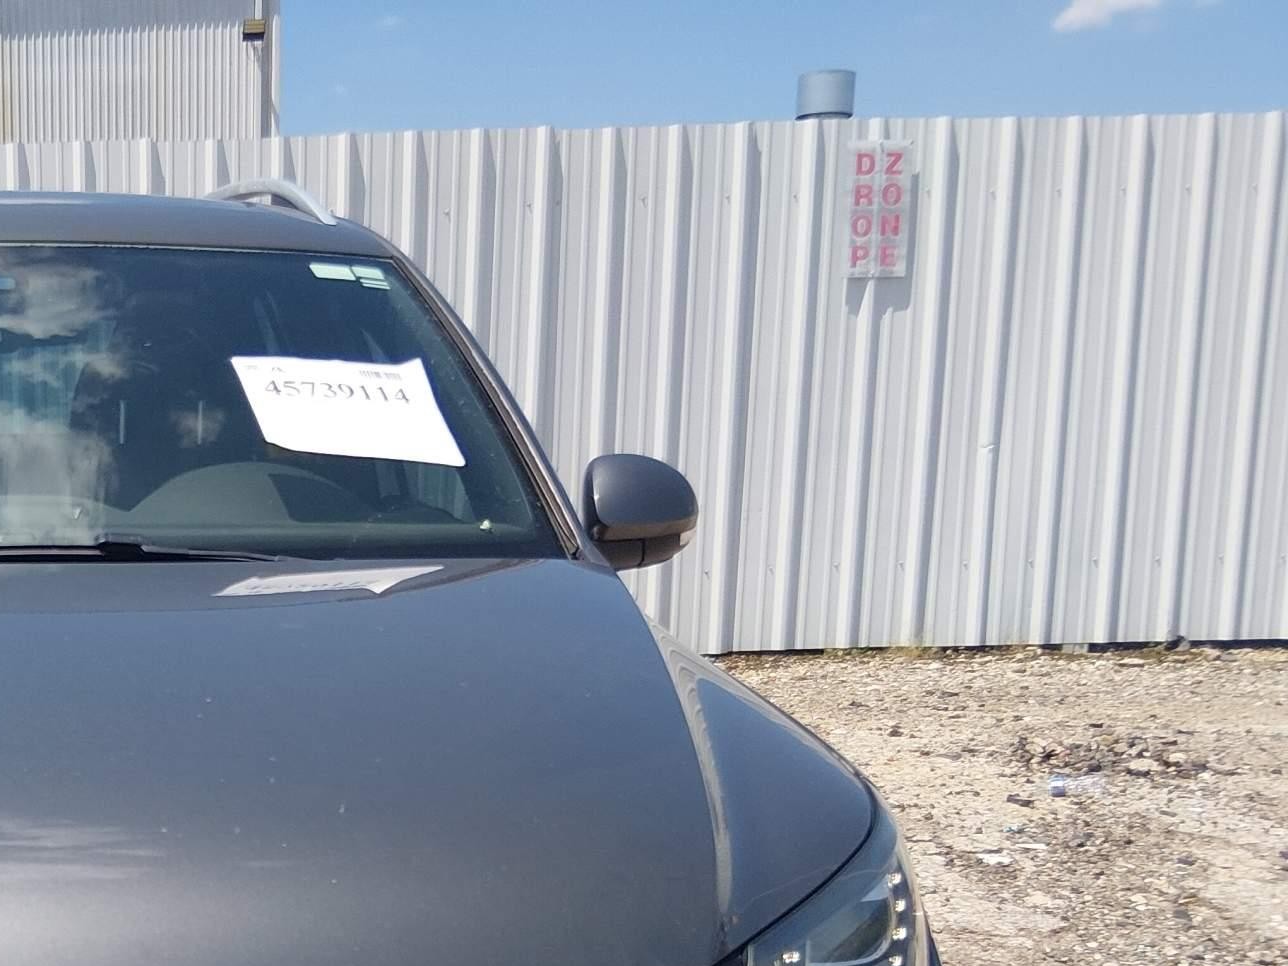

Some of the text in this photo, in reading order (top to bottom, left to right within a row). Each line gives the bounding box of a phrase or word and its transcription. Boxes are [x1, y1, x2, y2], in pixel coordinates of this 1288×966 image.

[849, 152, 876, 269] DROP
[879, 151, 904, 268] ZONE
[265, 379, 411, 404] 45739114
